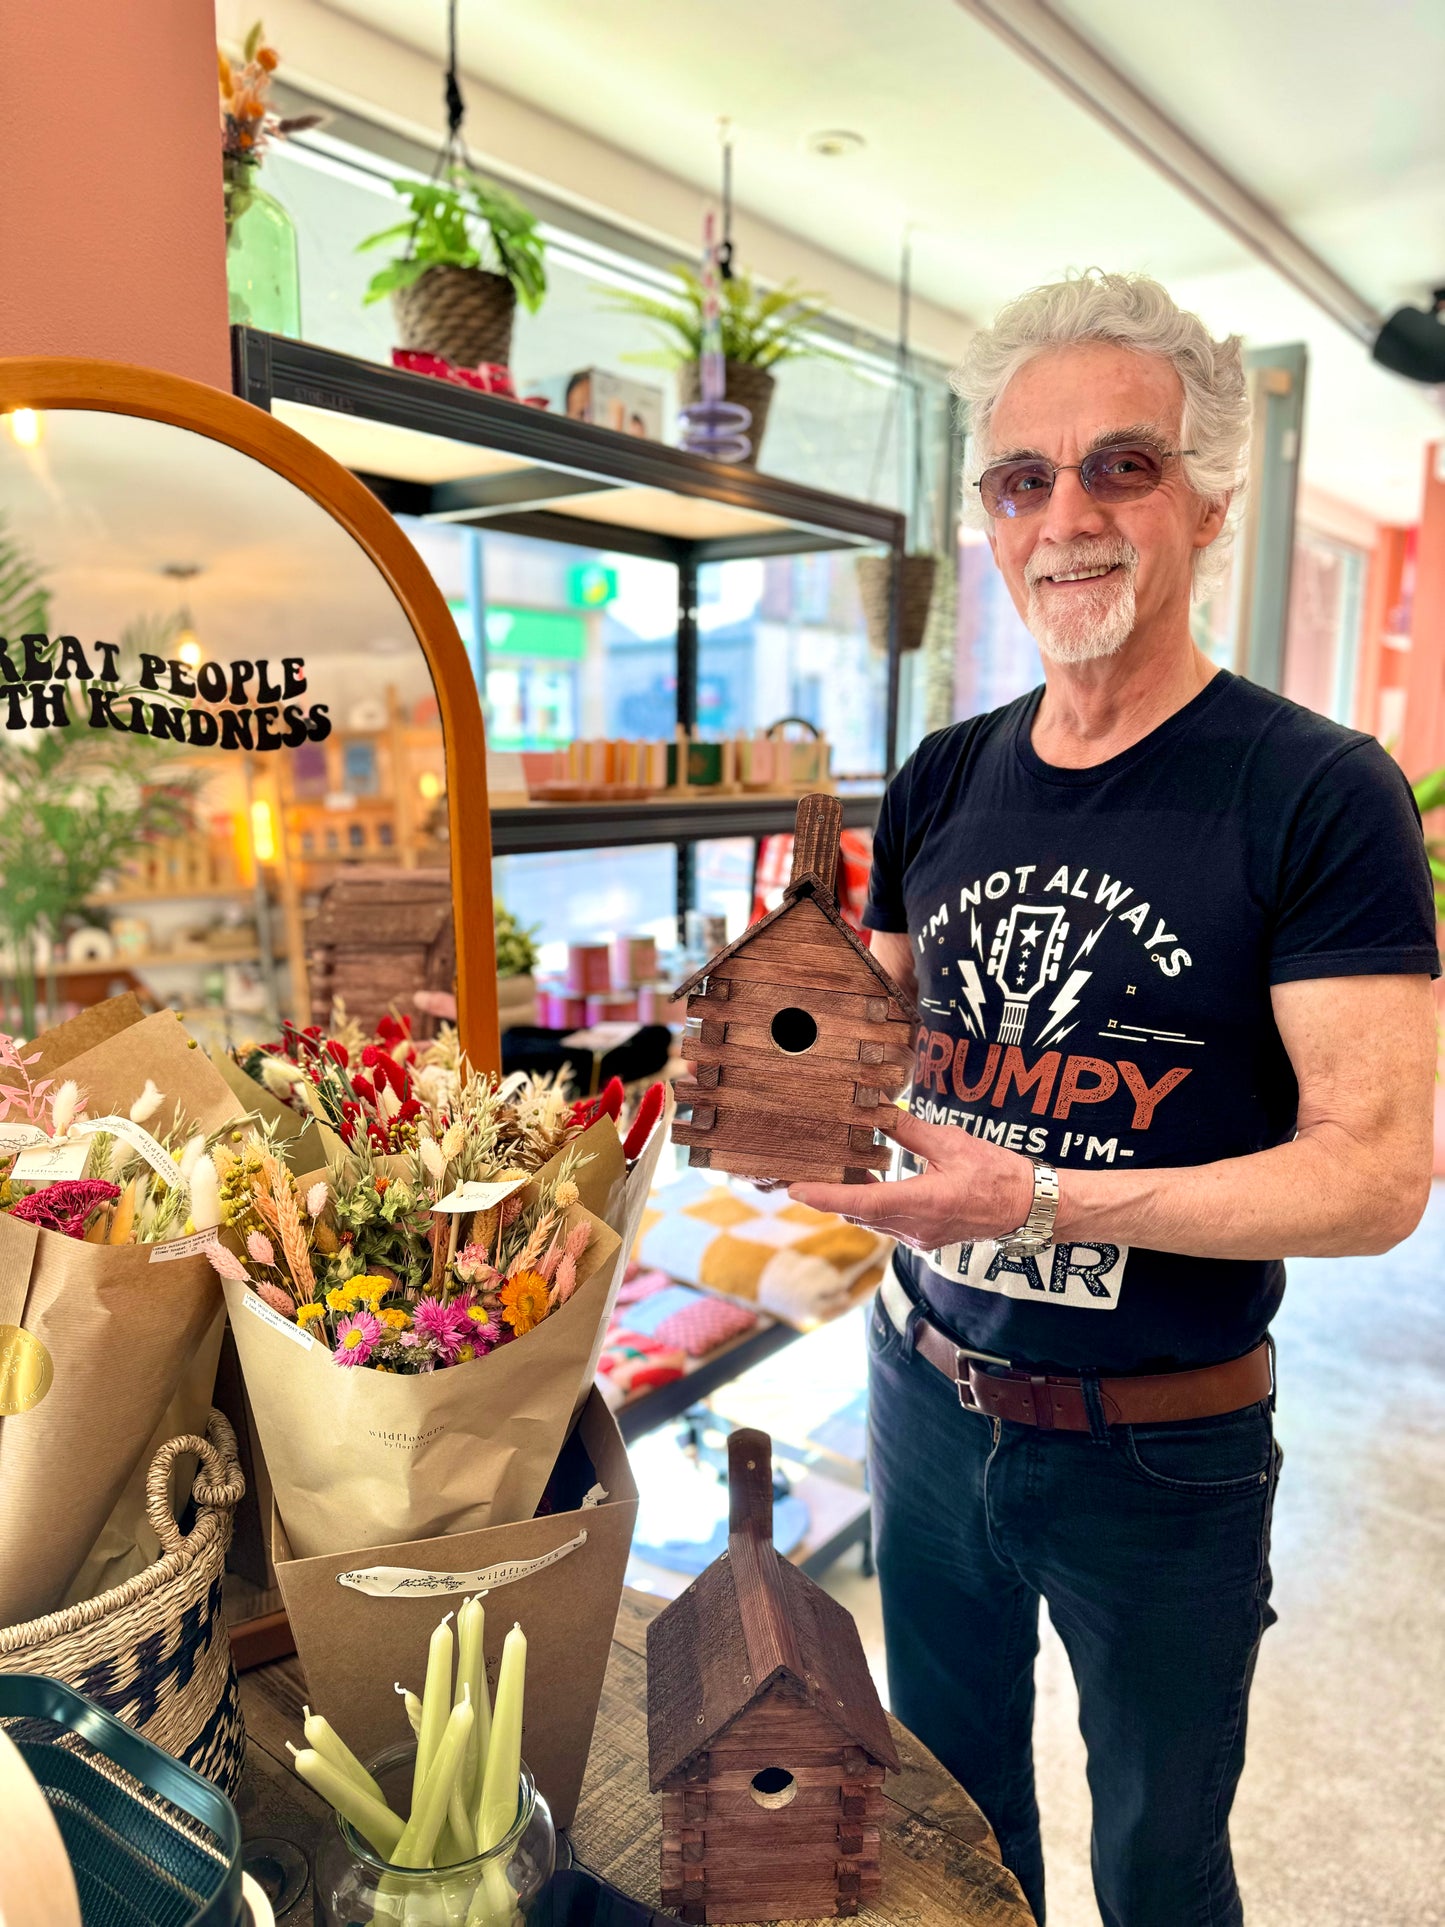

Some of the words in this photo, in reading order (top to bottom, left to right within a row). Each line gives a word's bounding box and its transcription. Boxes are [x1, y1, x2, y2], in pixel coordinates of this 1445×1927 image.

[139, 653, 307, 705] PEOPLE
[87, 688, 331, 750] KINDNESS
[917, 903, 949, 953] I'M
[960, 865, 1036, 913] NOT
[1044, 865, 1192, 977] ALWAYS
[915, 1025, 1192, 1130] GRUMPY
[368, 1424, 445, 1442] wildflowers
[477, 1552, 559, 1581] wildflowers
